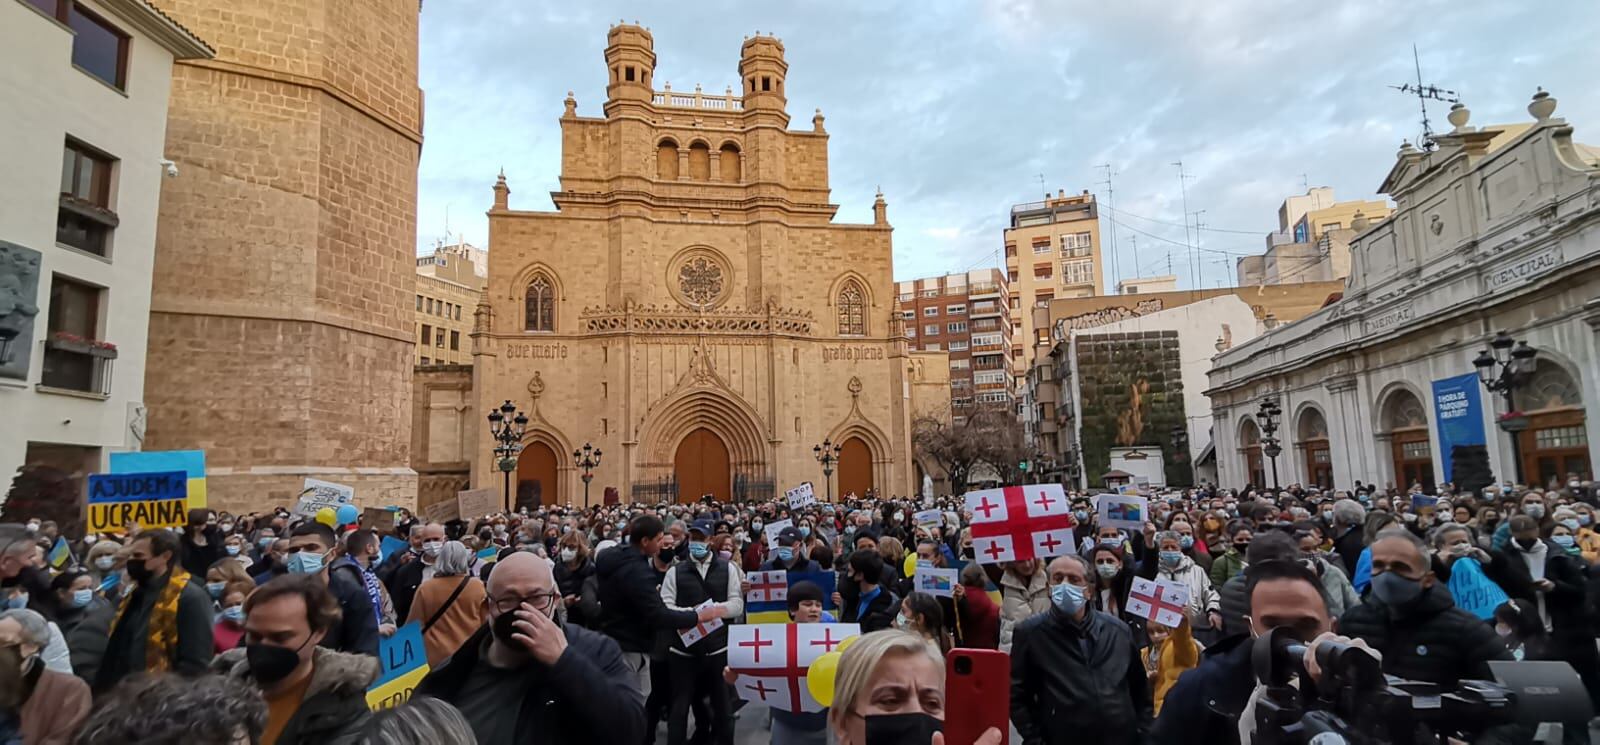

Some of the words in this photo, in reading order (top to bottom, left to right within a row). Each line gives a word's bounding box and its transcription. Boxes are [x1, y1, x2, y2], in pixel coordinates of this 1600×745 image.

[1493, 254, 1554, 286] CENTRAL
[1457, 391, 1466, 400] DE
[92, 476, 170, 498] AJUDEM
[788, 485, 810, 497] STOP
[389, 640, 415, 671] LA
